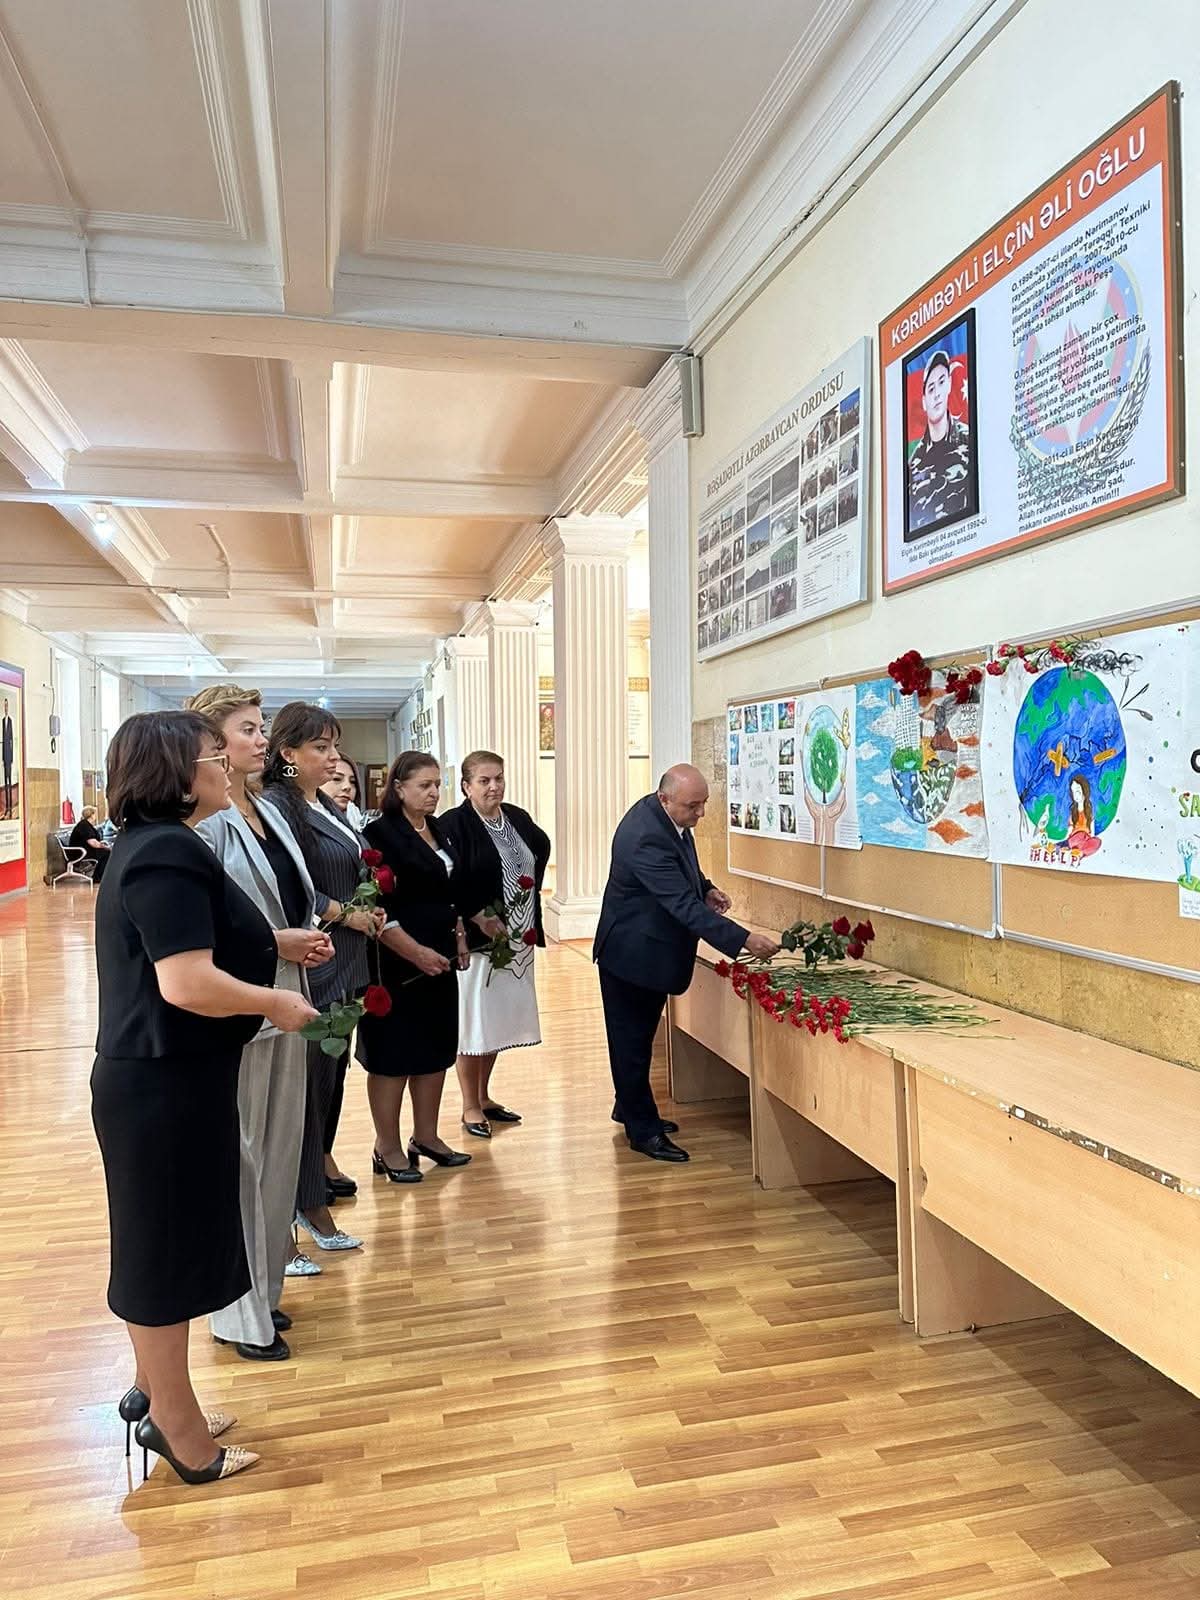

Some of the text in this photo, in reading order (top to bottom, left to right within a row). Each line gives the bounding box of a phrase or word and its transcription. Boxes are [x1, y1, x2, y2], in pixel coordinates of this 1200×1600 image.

[1120, 198, 1150, 228] Texniki
[891, 127, 1146, 348] KƏRİMBƏYLİ ELÇİN ƏLİ OĞLU
[1085, 221, 1138, 265] 2007-2010-cu
[1084, 242, 1127, 277] rayonunda
[1039, 307, 1044, 318] 3
[1091, 322, 1101, 335] bir
[801, 371, 845, 420] ORDUSU
